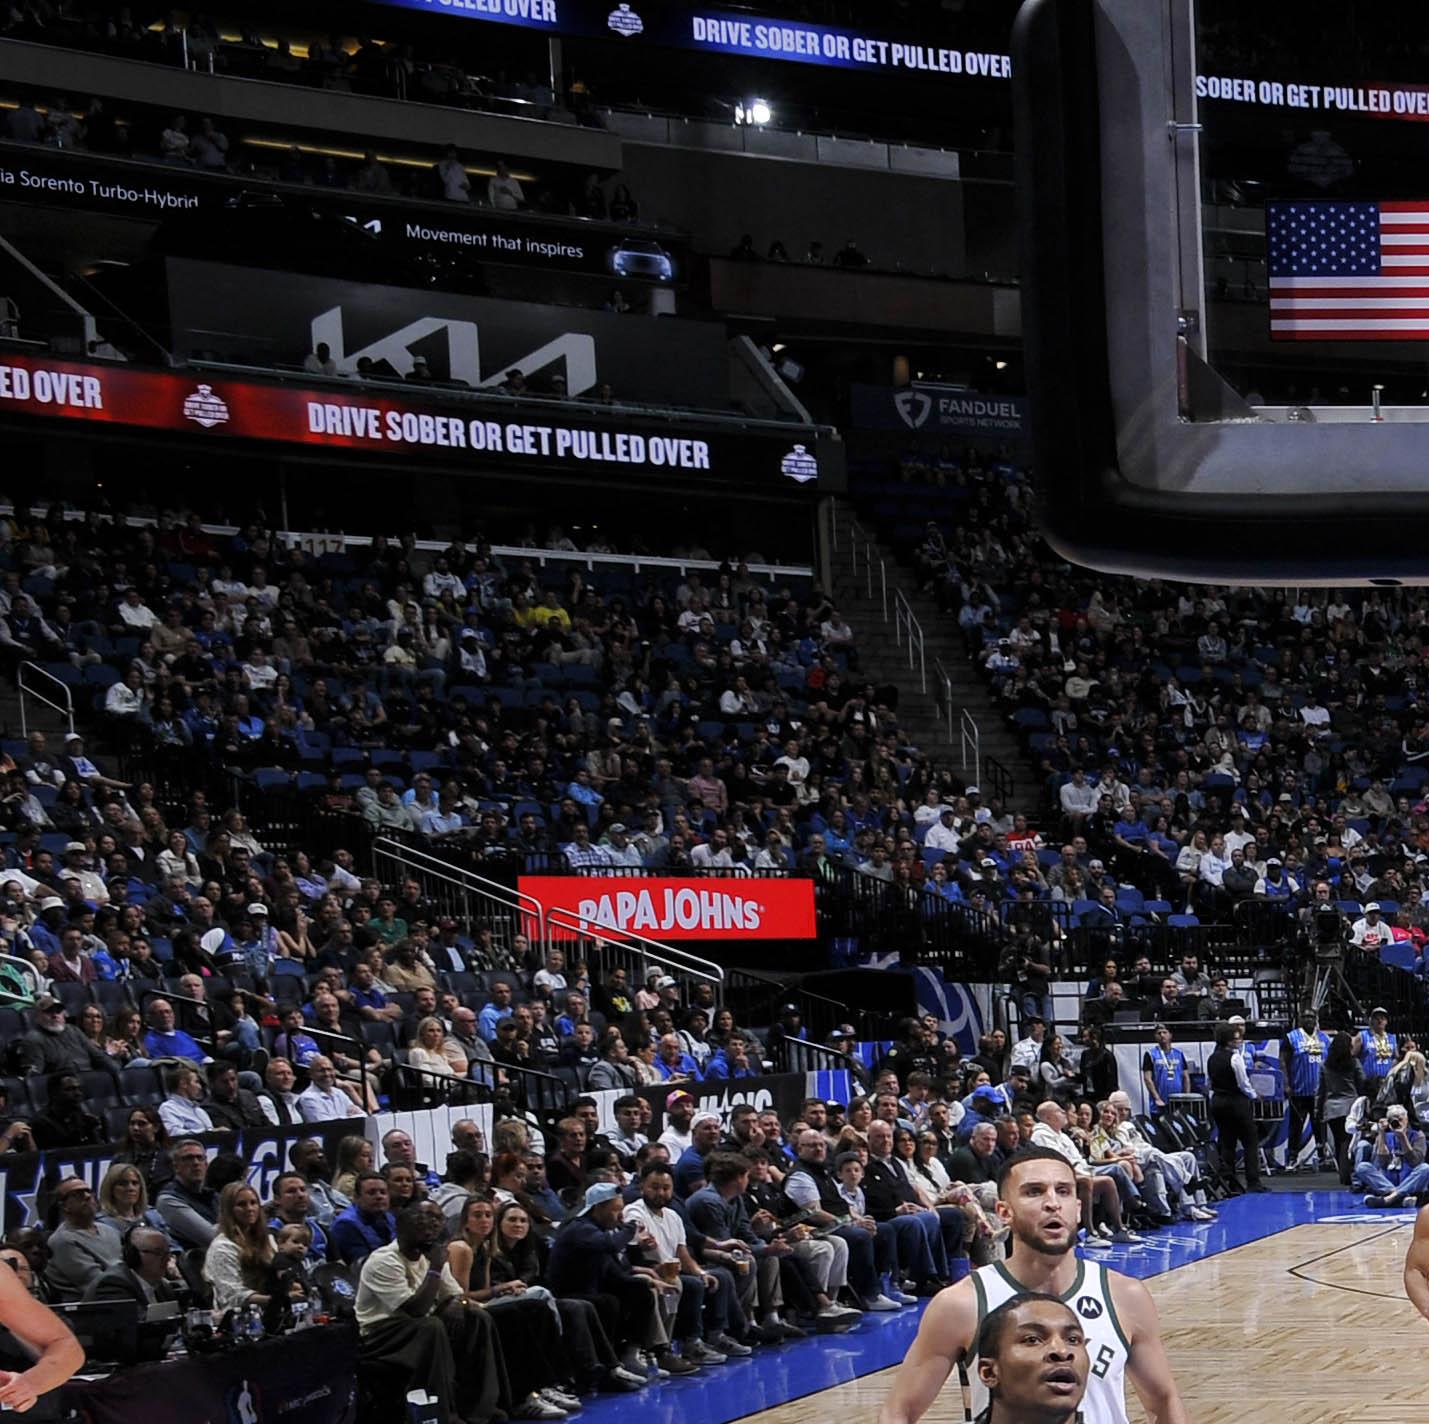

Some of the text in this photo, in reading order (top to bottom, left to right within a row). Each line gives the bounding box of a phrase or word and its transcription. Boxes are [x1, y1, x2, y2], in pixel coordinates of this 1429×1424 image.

[504, 0, 557, 22] OVER
[693, 17, 1012, 78] DRIVE SOBER OR GET PULLED OVER
[1196, 75, 1254, 102] SOBER
[1259, 80, 1288, 105] OR
[1288, 84, 1321, 108] GET
[1324, 86, 1392, 112] PULLED
[20, 171, 85, 193] Sorento
[406, 223, 489, 250] Movement
[491, 234, 522, 254] that
[526, 237, 584, 260] inspires
[311, 305, 597, 398] KIA
[31, 371, 102, 410] OVER
[939, 399, 1022, 418] FANDUEL
[307, 402, 711, 470] DRIVE SOBER OR GET PULLED OVER
[939, 415, 1022, 430] SPORTS NETWORK
[305, 537, 344, 554] 117
[578, 887, 760, 930] PAPA JOHNS
